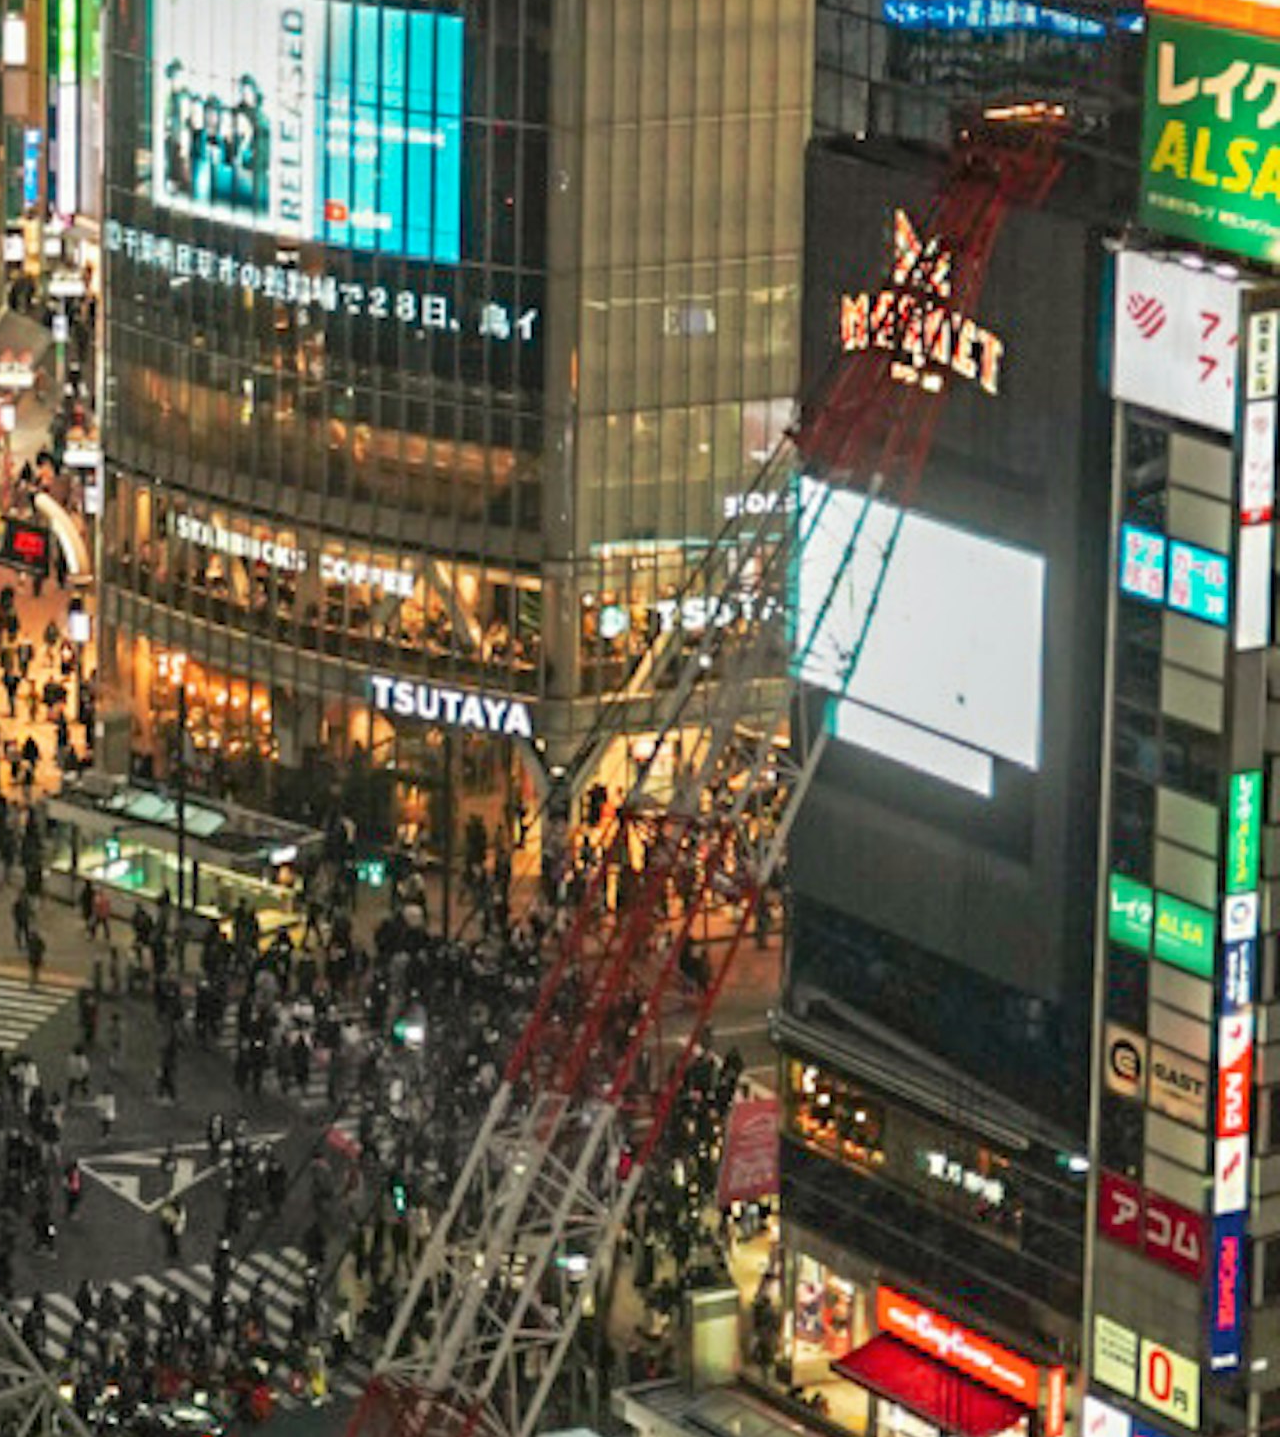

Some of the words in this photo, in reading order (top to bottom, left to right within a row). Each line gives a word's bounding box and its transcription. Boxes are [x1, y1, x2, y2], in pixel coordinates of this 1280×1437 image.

[175, 512, 306, 571] STARBUCKS
[319, 553, 415, 598] COFFEE
[372, 675, 532, 737] TSUTAYA
[1112, 1191, 1200, 1261] アコム
